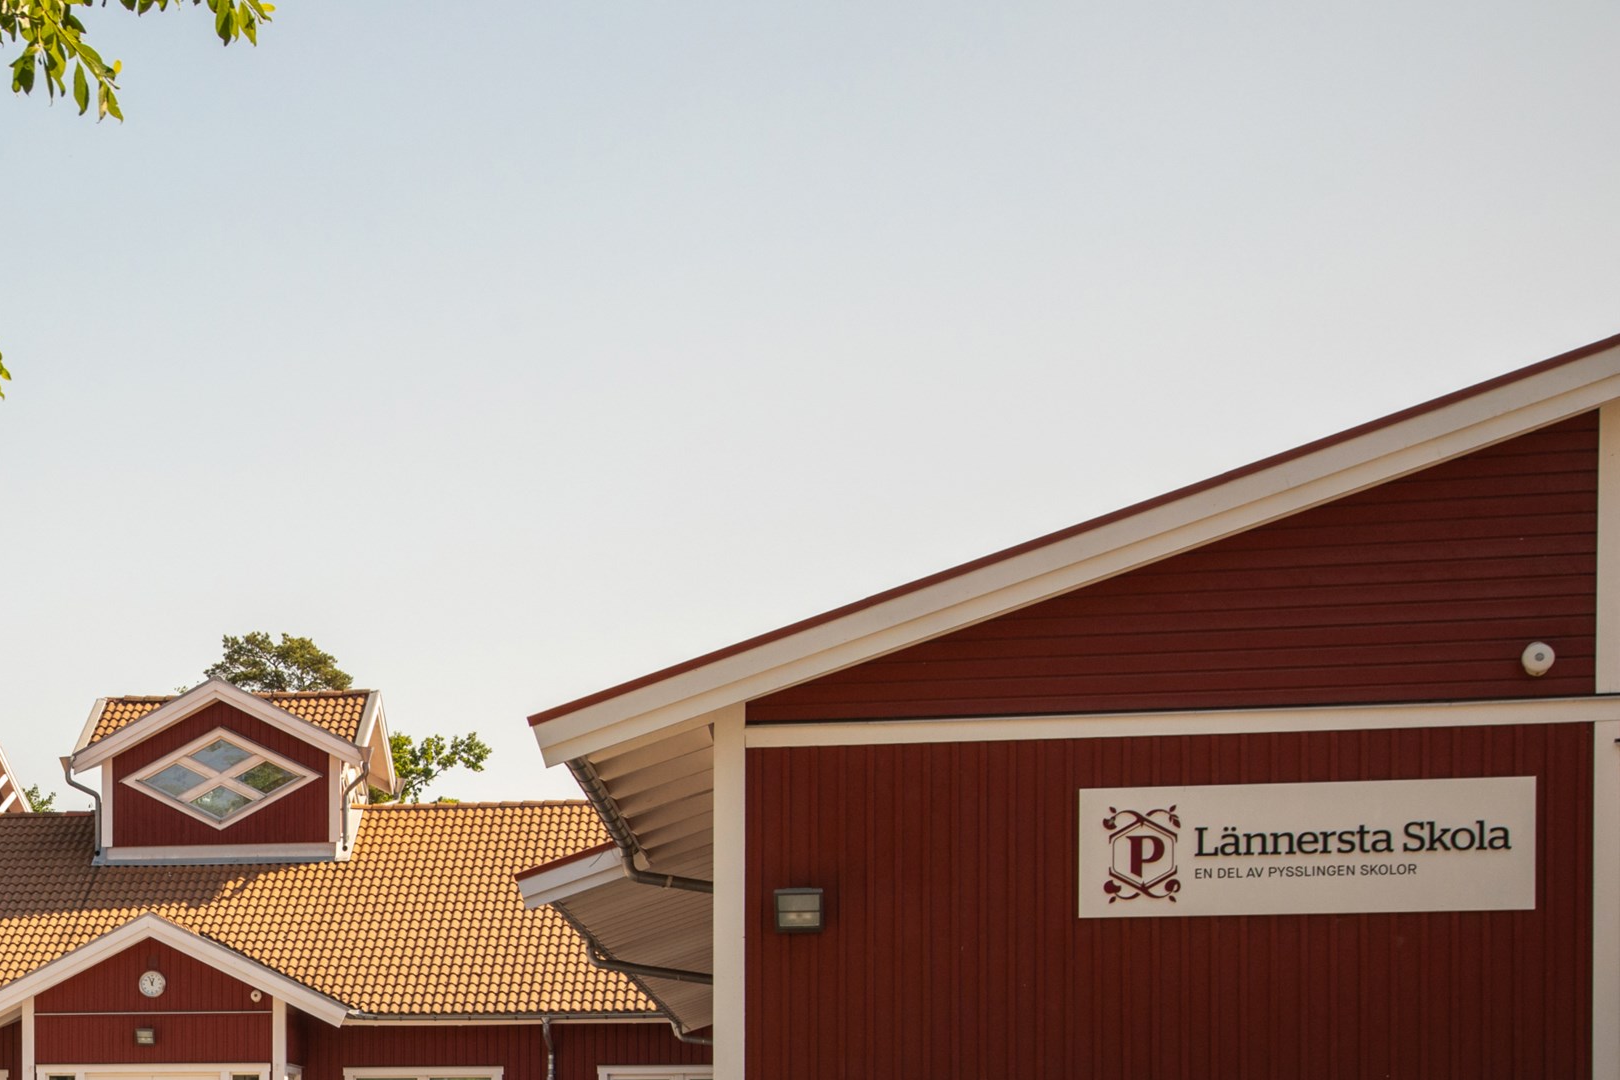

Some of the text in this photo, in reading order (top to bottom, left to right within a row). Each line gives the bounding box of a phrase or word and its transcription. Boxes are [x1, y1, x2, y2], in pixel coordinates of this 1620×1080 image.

[1194, 819, 1512, 857] Lännersta Skola
[1194, 862, 1417, 880] EN DEL AV PYSSLINGEN SKOLOR
